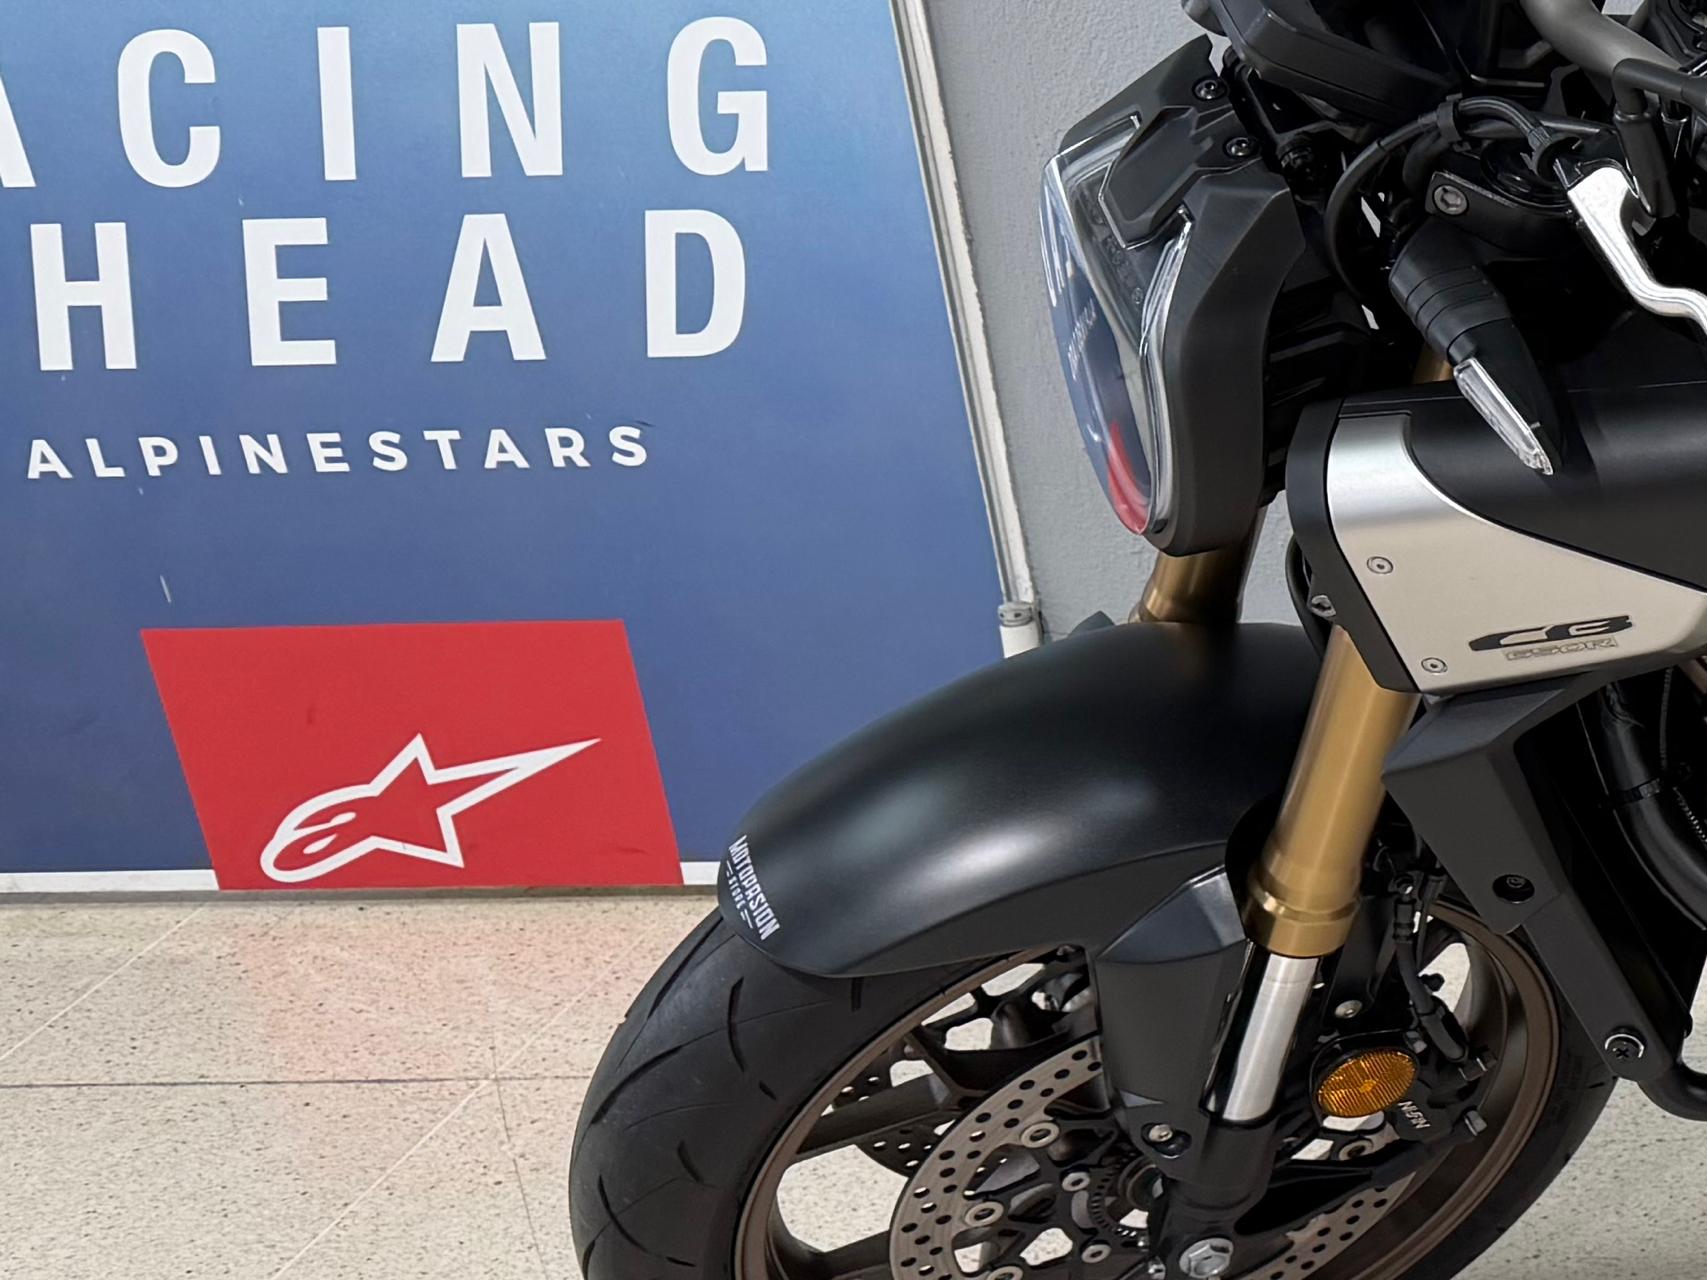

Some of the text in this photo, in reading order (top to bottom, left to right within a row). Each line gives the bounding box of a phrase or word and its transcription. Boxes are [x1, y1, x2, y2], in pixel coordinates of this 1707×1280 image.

[29, 208, 748, 372] HEAD
[26, 425, 650, 480] ALPINESTARS
[728, 834, 781, 941] MOTOPASION
